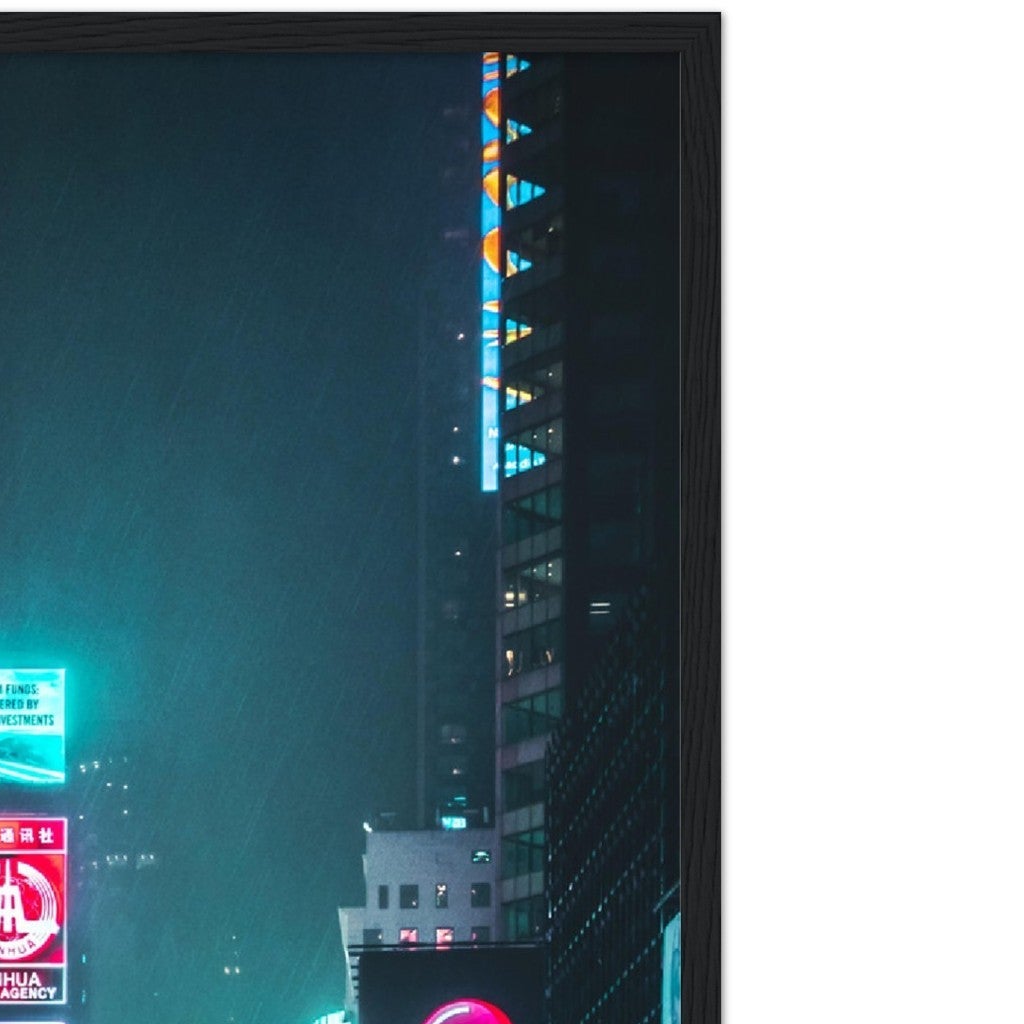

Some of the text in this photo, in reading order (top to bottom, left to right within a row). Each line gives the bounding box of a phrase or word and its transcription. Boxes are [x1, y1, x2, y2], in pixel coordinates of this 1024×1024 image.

[6, 684, 40, 695] FUNDS:
[27, 699, 39, 710] BY
[0, 987, 58, 999] AGENCY
